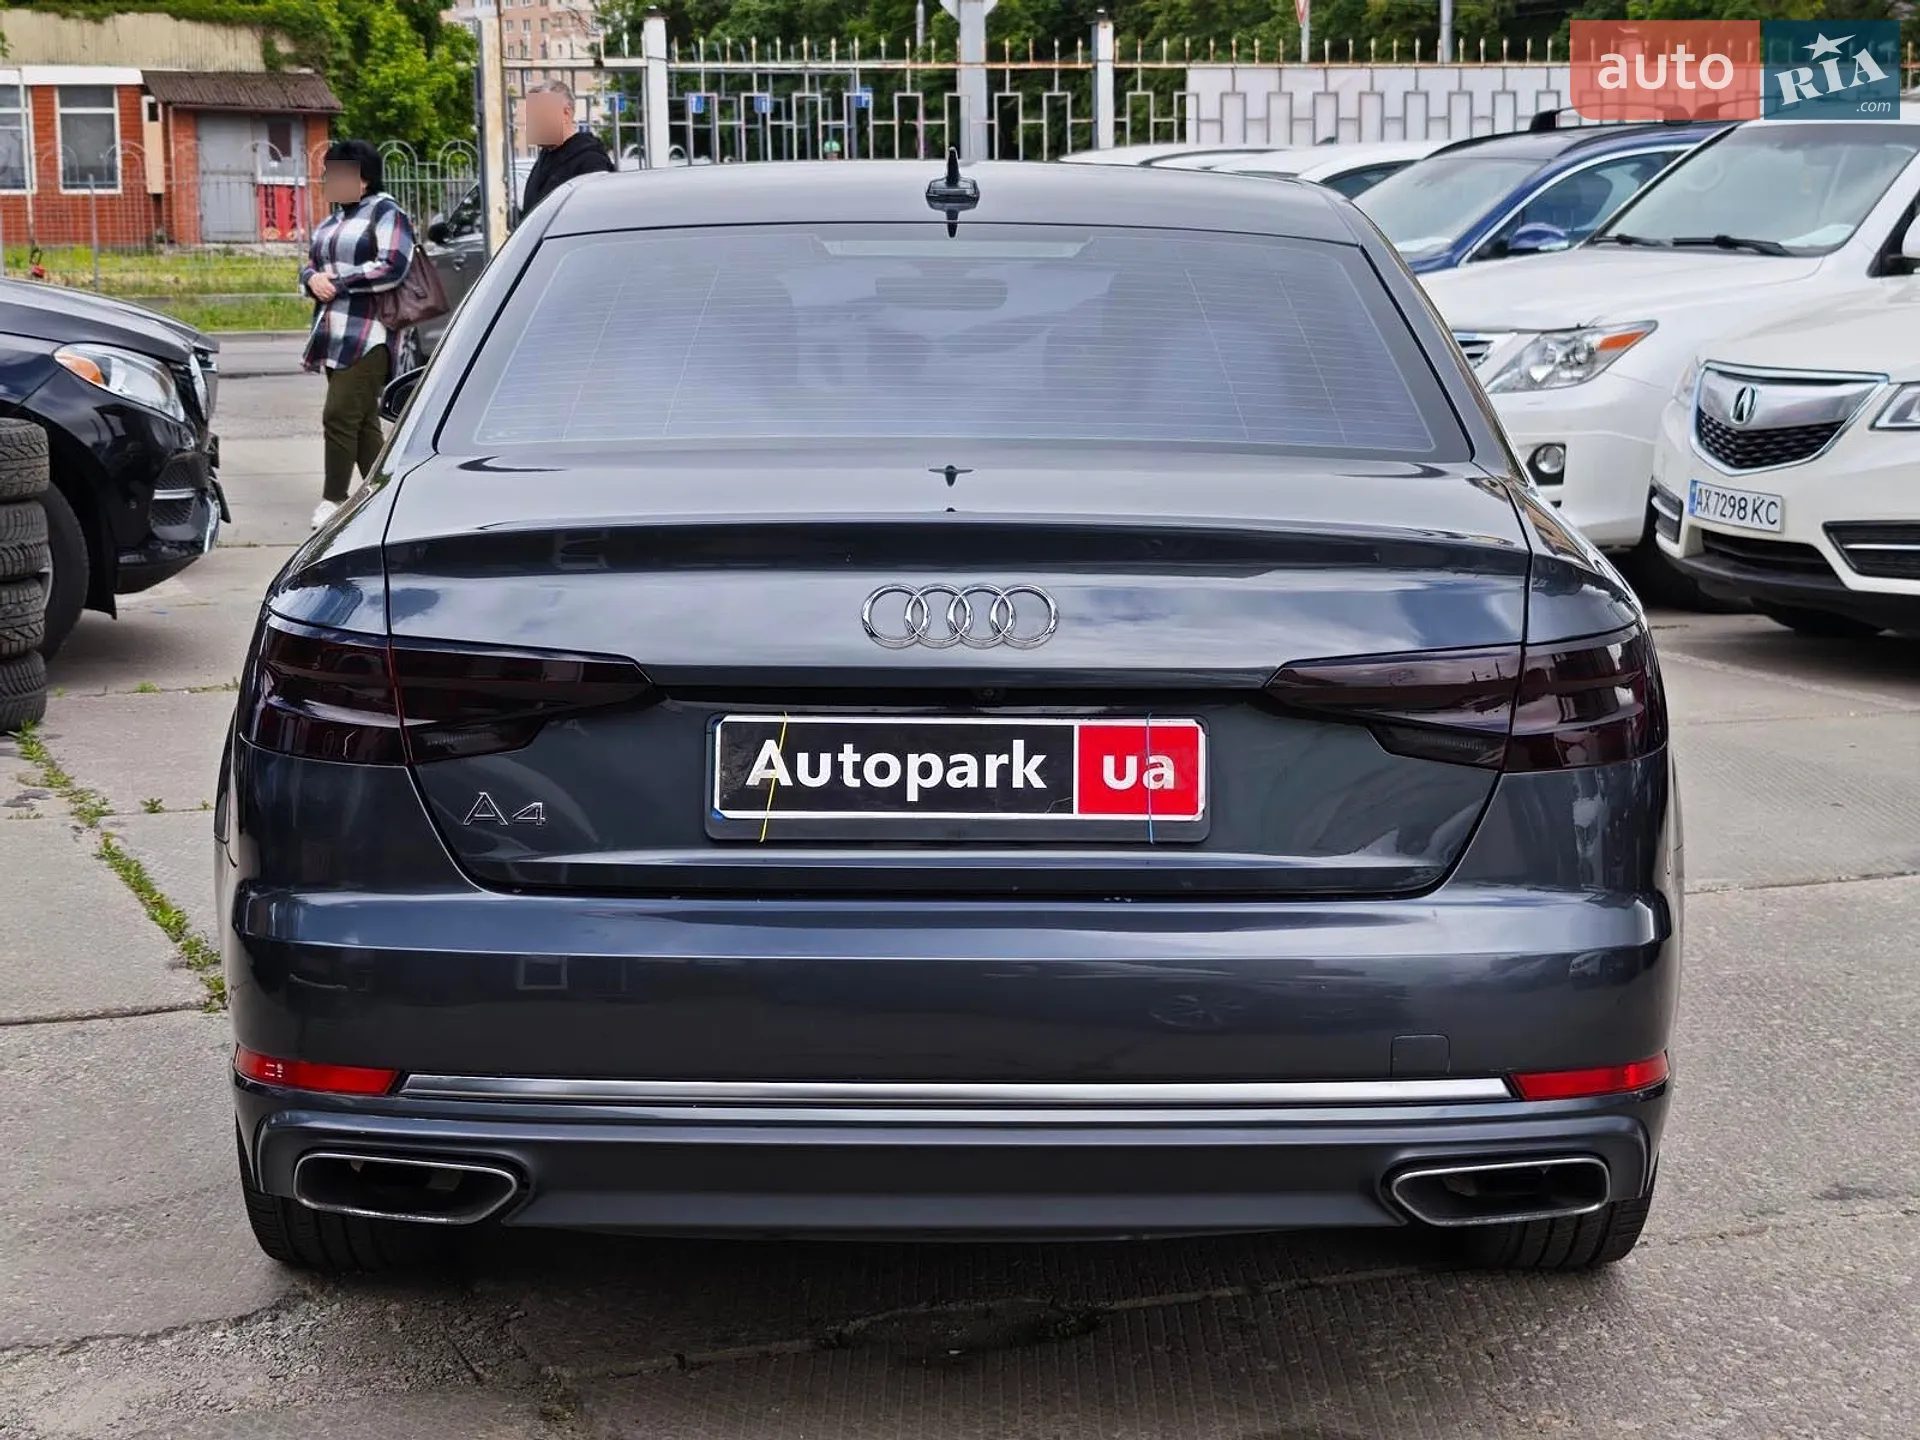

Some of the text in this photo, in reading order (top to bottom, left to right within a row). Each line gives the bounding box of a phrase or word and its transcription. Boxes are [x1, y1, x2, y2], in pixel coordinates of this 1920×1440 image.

[746, 739, 1175, 802] Autopark ua
[463, 791, 546, 826] A4
